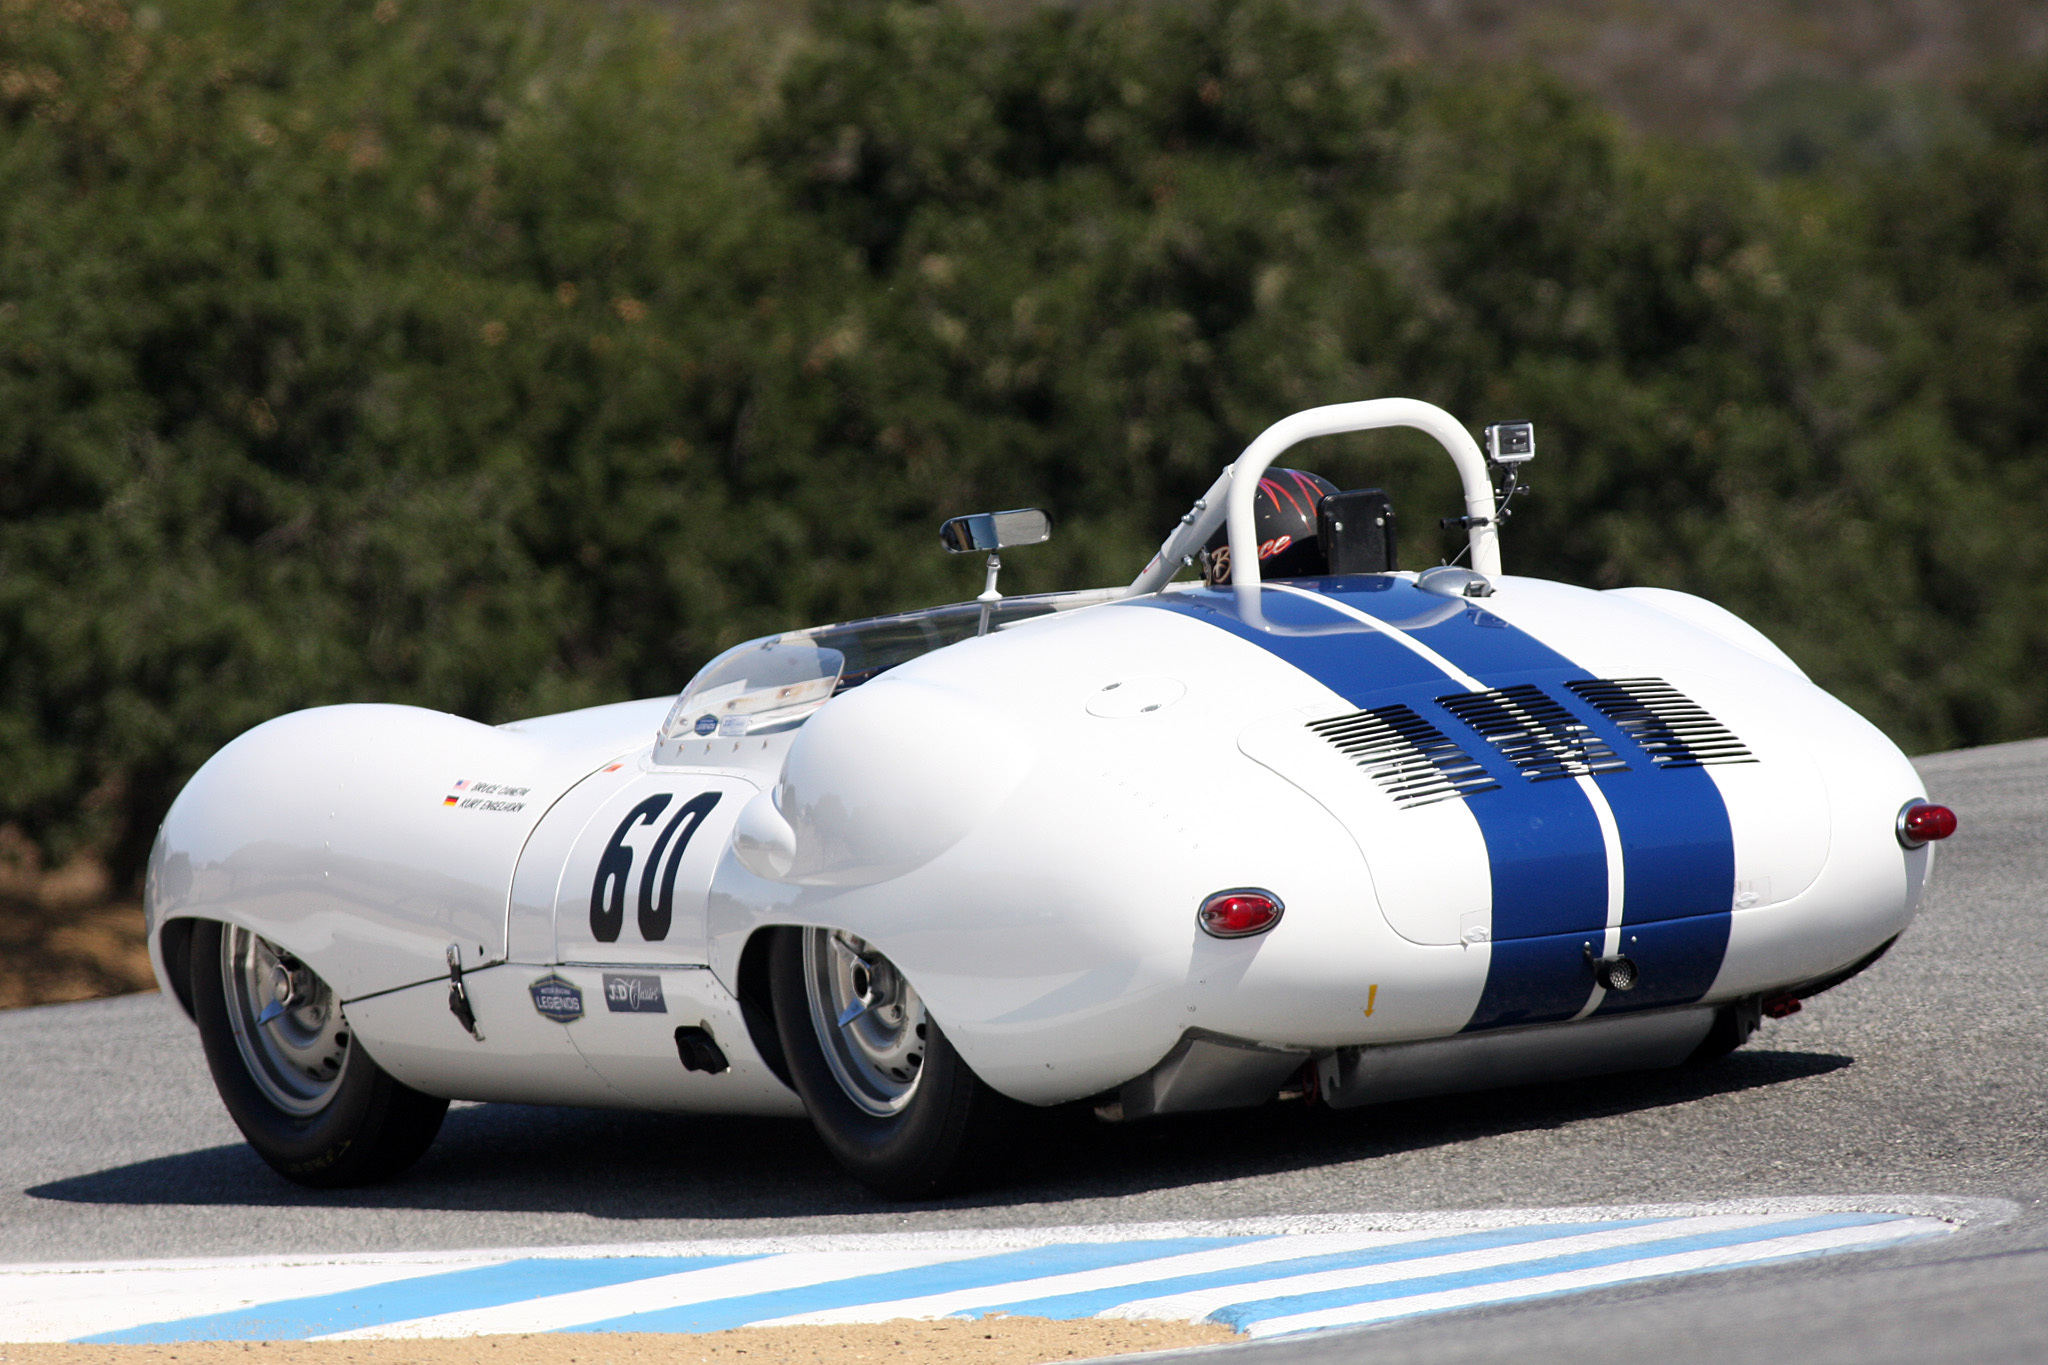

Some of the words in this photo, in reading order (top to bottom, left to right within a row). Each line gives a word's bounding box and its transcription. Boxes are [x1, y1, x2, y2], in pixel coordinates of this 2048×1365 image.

[1211, 534, 1292, 584] Bce
[459, 798, 484, 809] KURT
[589, 791, 723, 943] 60
[535, 995, 580, 1011] LEGENDS
